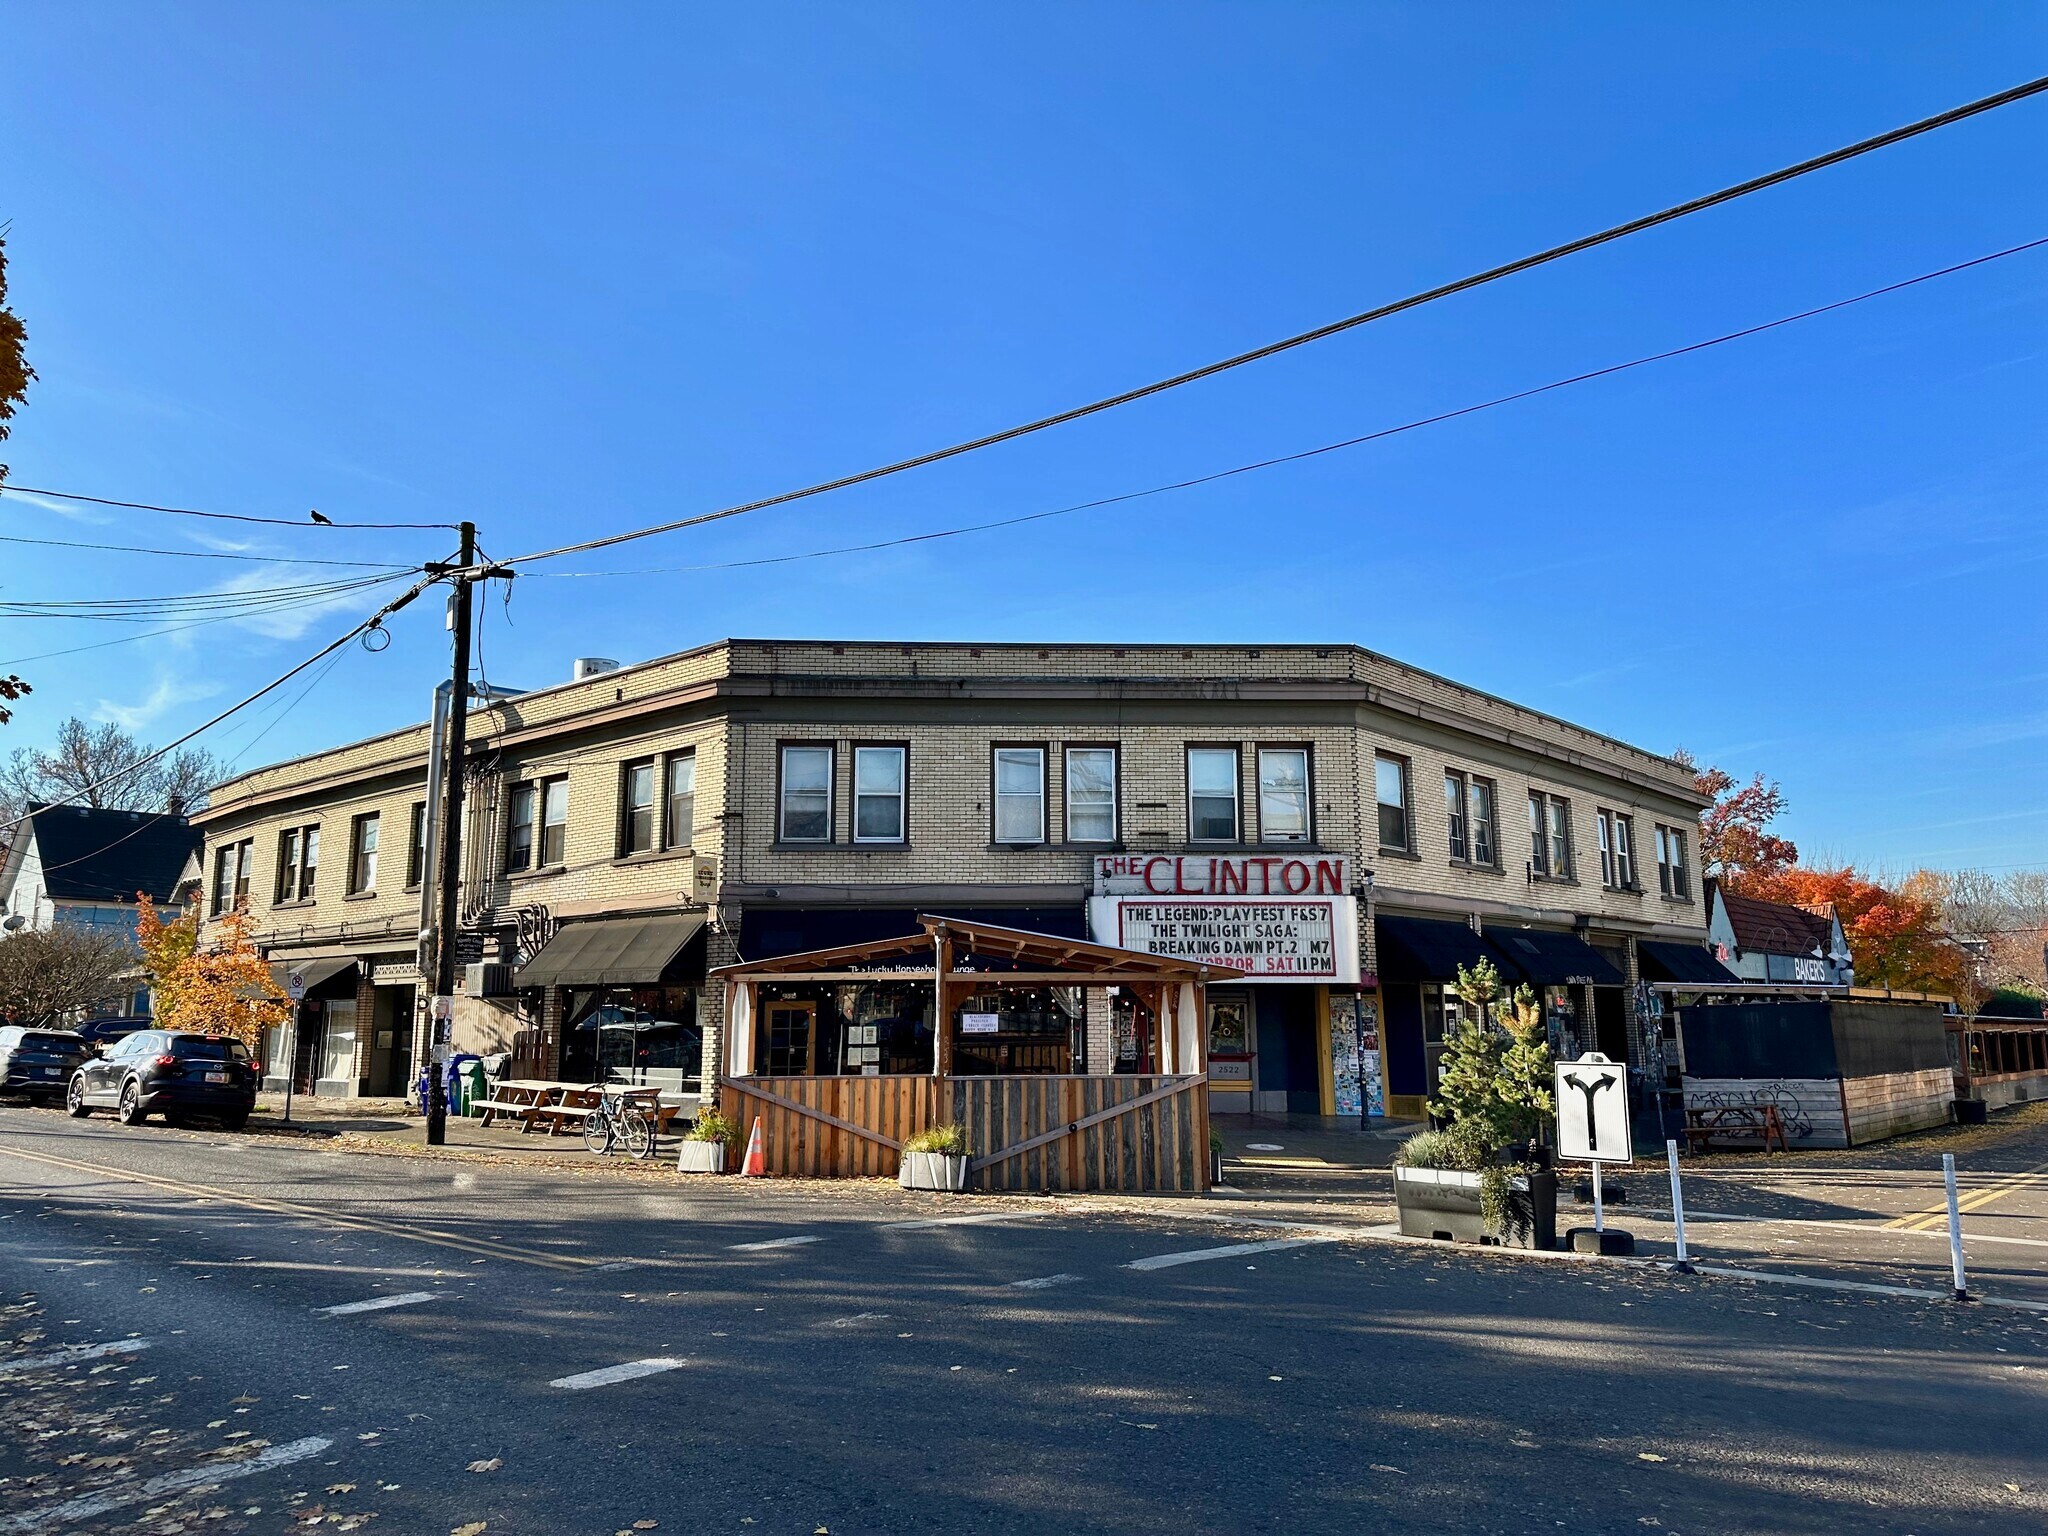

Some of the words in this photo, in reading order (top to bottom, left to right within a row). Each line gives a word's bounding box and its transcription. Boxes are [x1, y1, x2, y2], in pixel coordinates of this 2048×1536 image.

[1097, 857, 1143, 875] THE
[1144, 856, 1344, 895] CLINTON
[1126, 908, 1152, 921] THE
[1150, 924, 1177, 937] THE
[1181, 924, 1250, 938] TWILIGHT
[1255, 924, 1298, 938] SAGA:
[1149, 941, 1220, 954] BREAKING
[1224, 941, 1263, 954] DAWN
[895, 964, 937, 973] Horsesho
[1266, 957, 1294, 971] SAT
[1218, 1066, 1240, 1074] 2522
